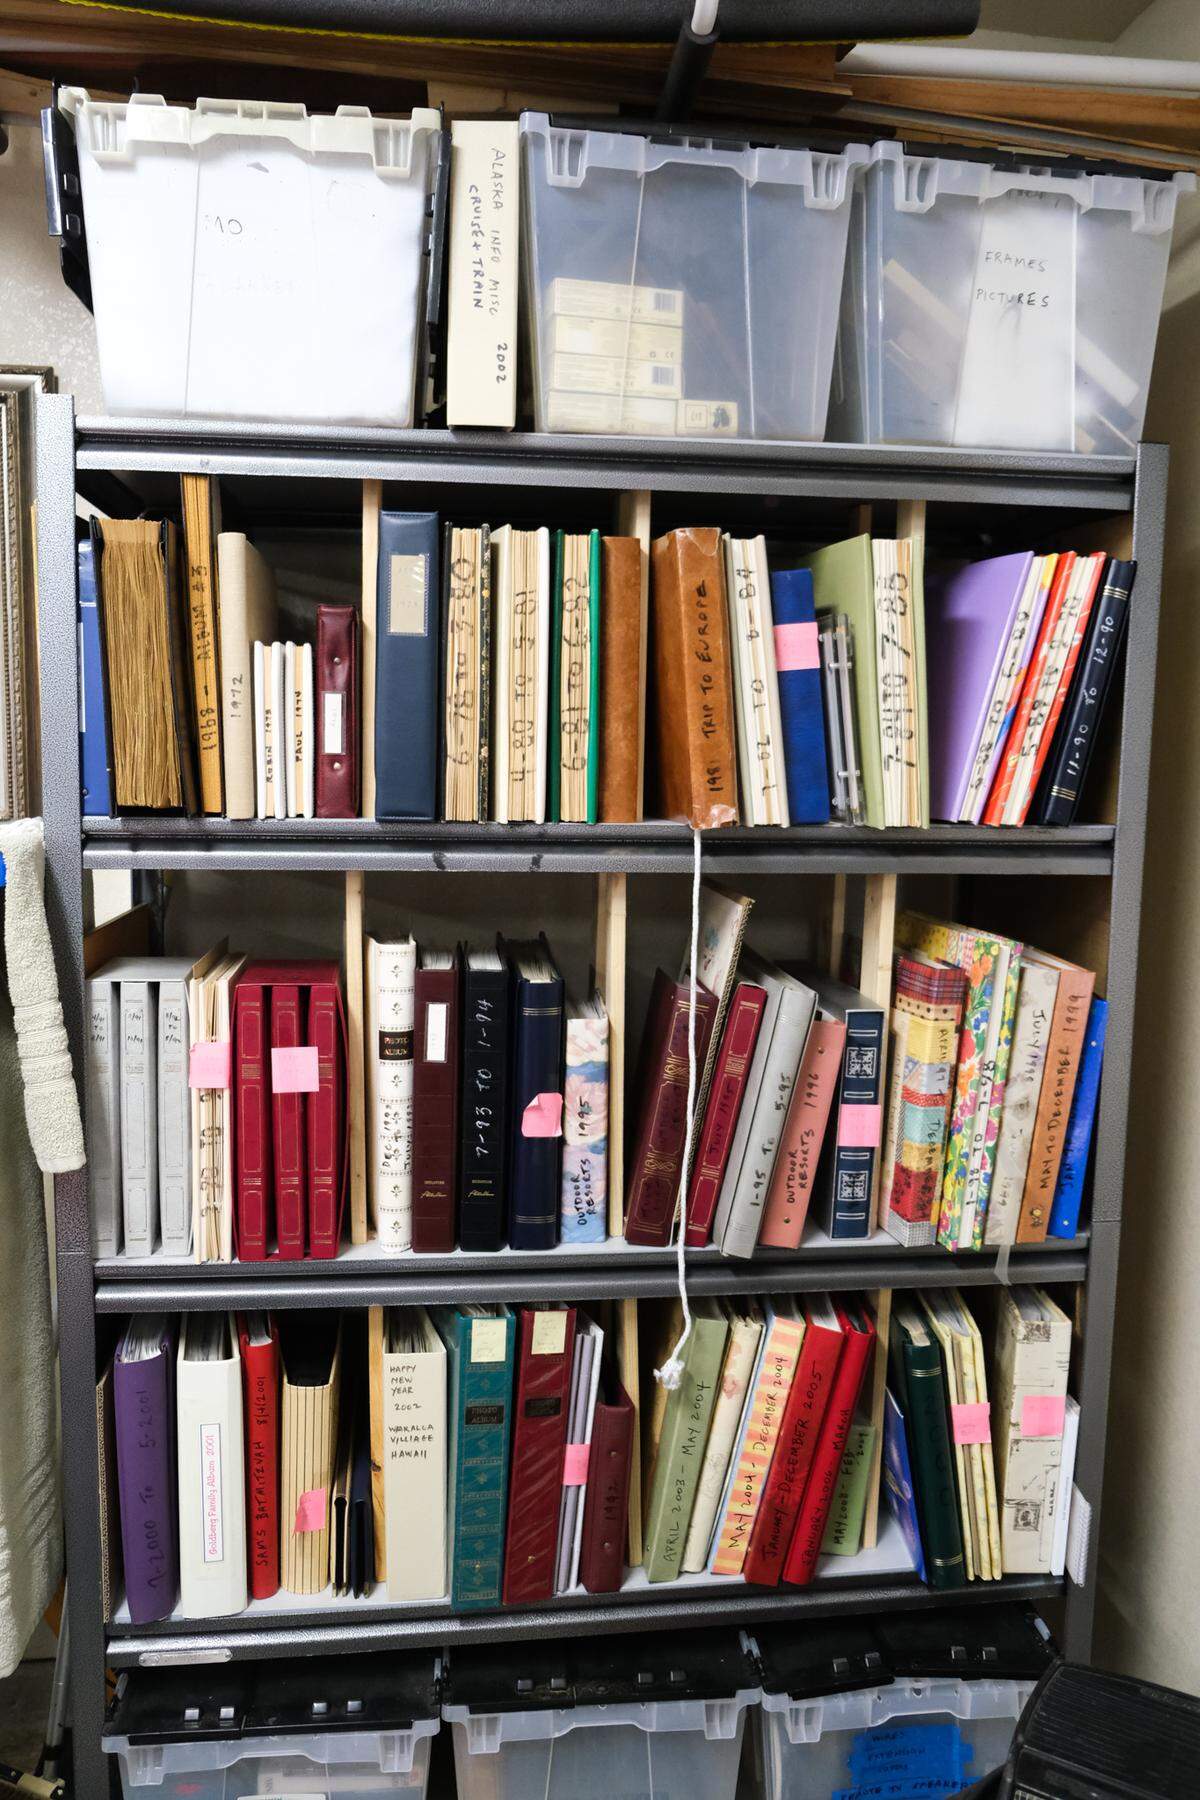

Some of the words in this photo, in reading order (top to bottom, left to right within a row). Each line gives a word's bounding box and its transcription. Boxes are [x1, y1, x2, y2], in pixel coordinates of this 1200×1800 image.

[493, 148, 506, 210] ALASKA
[469, 184, 485, 237] CRUISE
[490, 230, 502, 263] INFO
[985, 251, 1046, 272] FRAMES
[472, 257, 485, 309] TRAIN
[489, 279, 501, 316] MISC
[976, 288, 1050, 308] PICTURES
[496, 343, 508, 384] 2002
[192, 602, 212, 661] ALBUM
[696, 579, 713, 663] EUROPE
[231, 673, 244, 718] 1972
[567, 661, 583, 694] TO
[700, 675, 713, 696] TO
[751, 679, 767, 711] TO
[1066, 724, 1090, 777] 11-90
[1093, 615, 1116, 665] 12-90
[200, 706, 218, 751] 1968
[561, 706, 589, 771] 6-81
[703, 704, 717, 740] TRIP
[265, 744, 273, 783] ROBIN
[295, 730, 303, 764] PAUL
[384, 1036, 409, 1045] PHOTO
[476, 998, 493, 1048] 1-94
[1029, 1009, 1048, 1048] JULY
[384, 1048, 409, 1057] ALBUM
[479, 1067, 493, 1093] TO
[804, 1073, 820, 1109] 1996
[978, 1060, 996, 1113] 7-98
[1039, 1158, 1056, 1191] MAY
[1048, 1047, 1074, 1131] DECEMBER
[1062, 993, 1087, 1034] 1999
[476, 1107, 494, 1158] 7-93
[578, 1095, 593, 1138] 1995
[750, 1170, 767, 1207] 1-95
[774, 1074, 792, 1112] 5-95
[799, 1129, 815, 1190] RESORTS
[972, 1134, 984, 1158] TO
[585, 1158, 597, 1216] RESORTS
[787, 1148, 798, 1204] OUTDOOR
[966, 1167, 981, 1207] 1-98
[570, 1173, 588, 1227] OUTDOOR
[389, 1364, 416, 1373] HAPPY
[391, 1376, 413, 1384] NEW
[254, 1376, 270, 1426] 8/4/2001
[391, 1386, 413, 1396] YEAR
[394, 1403, 422, 1411] 2002
[691, 1381, 711, 1420] 2004
[139, 1390, 157, 1449] 5-2001
[471, 1407, 498, 1416] PHOTO
[471, 1416, 498, 1425] ALBUM
[205, 1435, 216, 1458] 2001
[391, 1450, 427, 1460] HAWAII
[682, 1427, 699, 1456] MAY
[728, 1513, 753, 1548] MAY
[742, 1472, 757, 1508] 2004
[752, 1391, 777, 1452] DECEMBER
[773, 1357, 789, 1386] 2004
[761, 1509, 791, 1562] JANUARY
[783, 1419, 812, 1494] DECEMBER
[804, 1360, 824, 1410] 2005
[206, 1460, 216, 1488] Album
[207, 1489, 217, 1518] Family
[672, 1480, 686, 1513] 2003
[208, 1518, 219, 1556] Goldberg
[665, 1521, 680, 1563] APRIL
[834, 1519, 848, 1545] MAY
